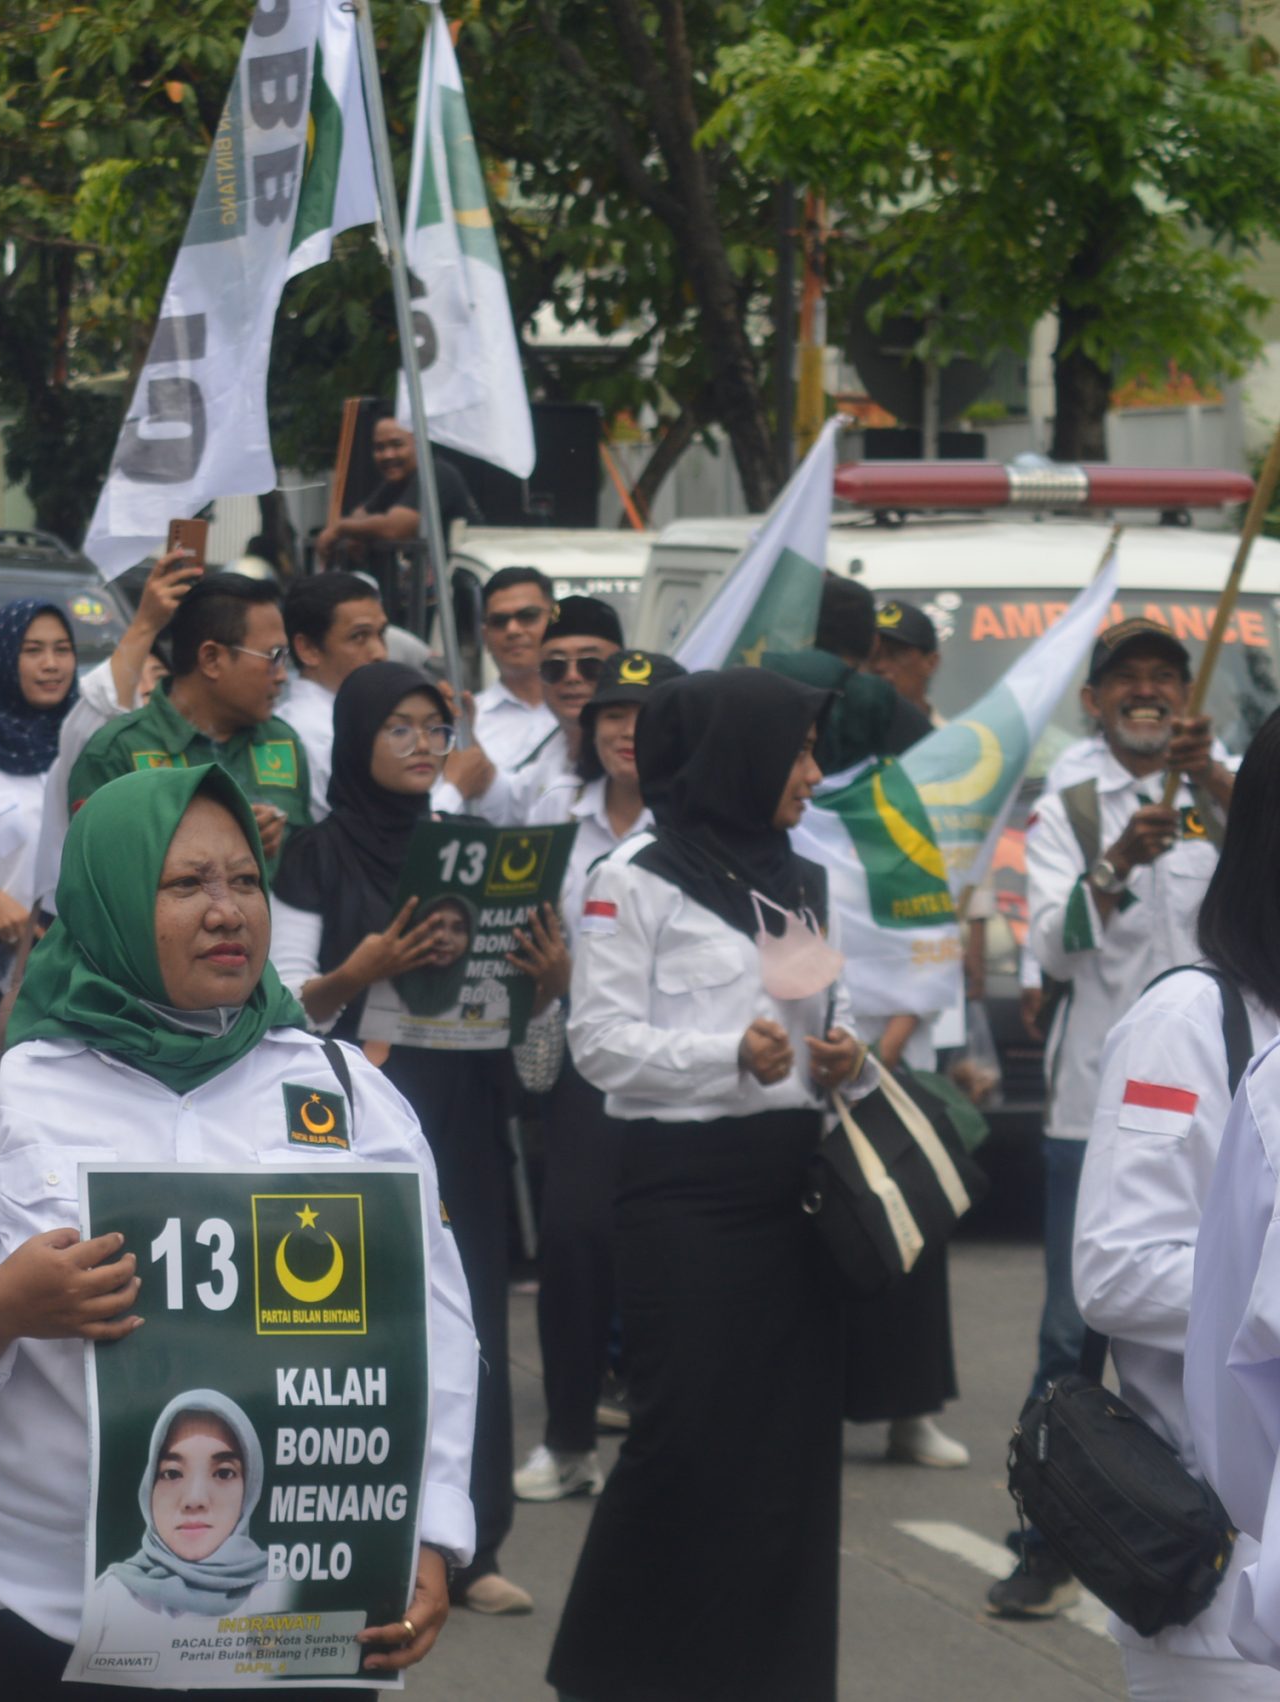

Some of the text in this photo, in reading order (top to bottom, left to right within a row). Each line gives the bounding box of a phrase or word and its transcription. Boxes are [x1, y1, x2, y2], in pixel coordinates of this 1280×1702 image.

[972, 603, 1269, 648] AMLANCE
[438, 839, 487, 885] 13
[151, 1217, 239, 1312] 13
[261, 1309, 360, 1324] PARTAI BULAN BINTANG
[276, 1367, 387, 1406] KALAH
[275, 1426, 391, 1466] BONDO
[269, 1483, 408, 1523] MENANG
[267, 1541, 353, 1582] BOLO
[171, 1637, 233, 1649] BACALEG
[235, 1635, 271, 1648] DPRD
[274, 1634, 302, 1646] Kota
[217, 1614, 321, 1634] INDRAWATI
[94, 1656, 153, 1669] IDRAWATI
[180, 1651, 215, 1662] Partai
[217, 1650, 252, 1661] Bulan
[255, 1648, 301, 1662] Bintang
[311, 1646, 338, 1658] PBB
